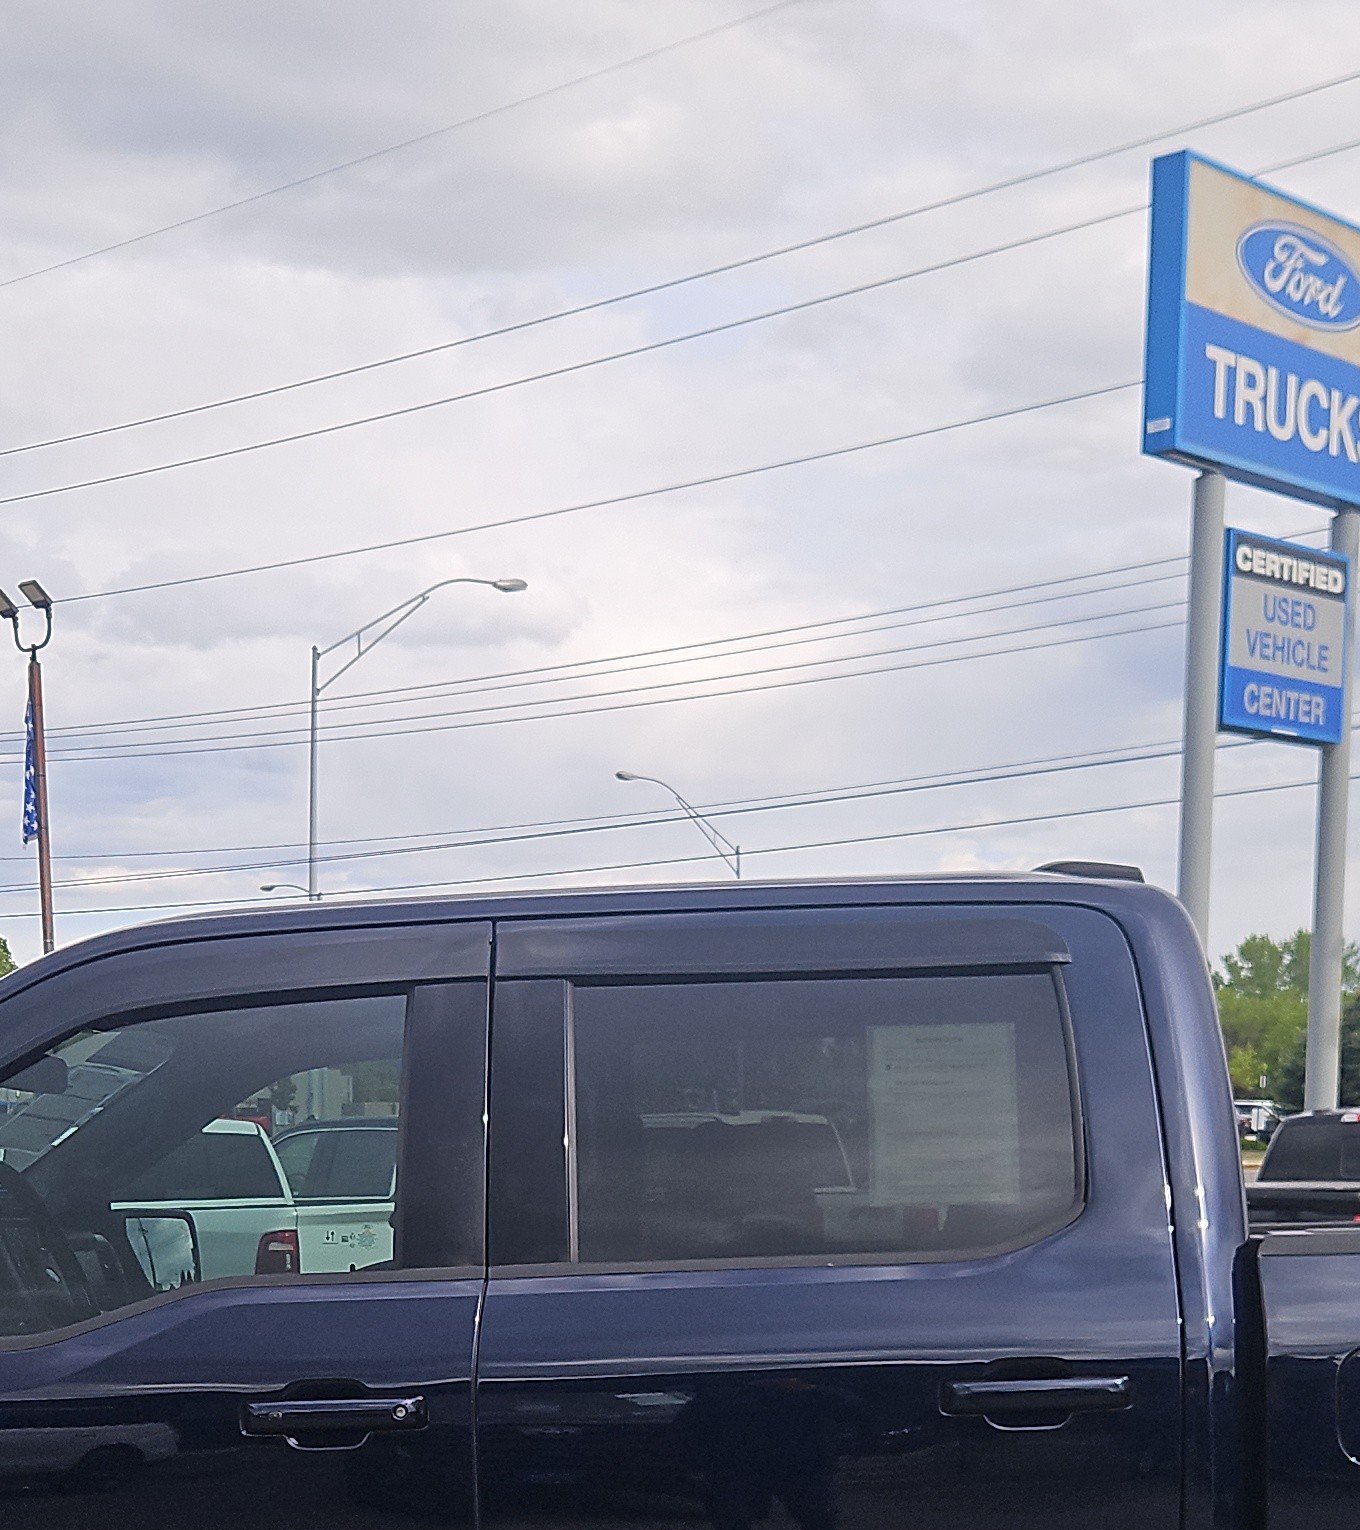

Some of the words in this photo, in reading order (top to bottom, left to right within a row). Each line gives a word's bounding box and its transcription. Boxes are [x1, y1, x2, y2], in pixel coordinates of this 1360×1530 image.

[1263, 234, 1348, 320] Ford
[1235, 545, 1345, 594] CERTIFIED
[1263, 593, 1316, 632] USED
[1245, 628, 1330, 673] VEHICLE
[1243, 683, 1326, 725] CENTER
